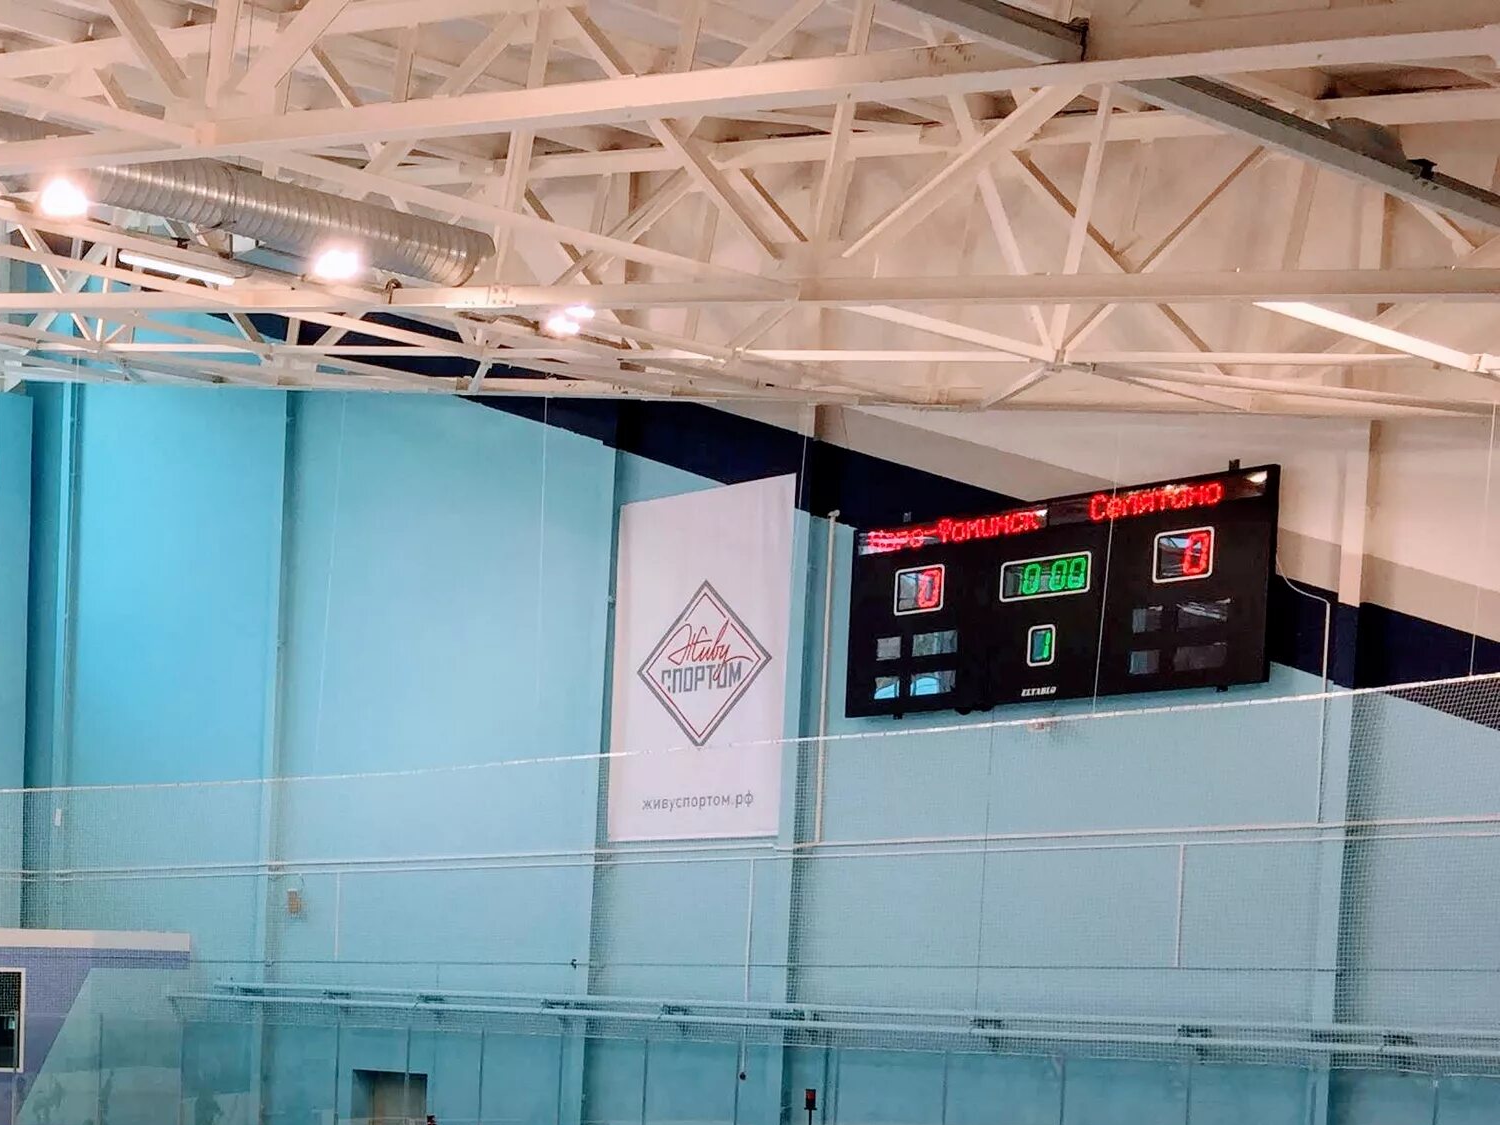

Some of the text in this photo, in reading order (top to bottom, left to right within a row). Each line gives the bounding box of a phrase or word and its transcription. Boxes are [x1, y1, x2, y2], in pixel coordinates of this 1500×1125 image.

[1182, 533, 1210, 575] 0
[668, 618, 753, 681] Живу
[661, 661, 742, 694] СПОРТОМ
[642, 790, 754, 812] живуспортом.рф
